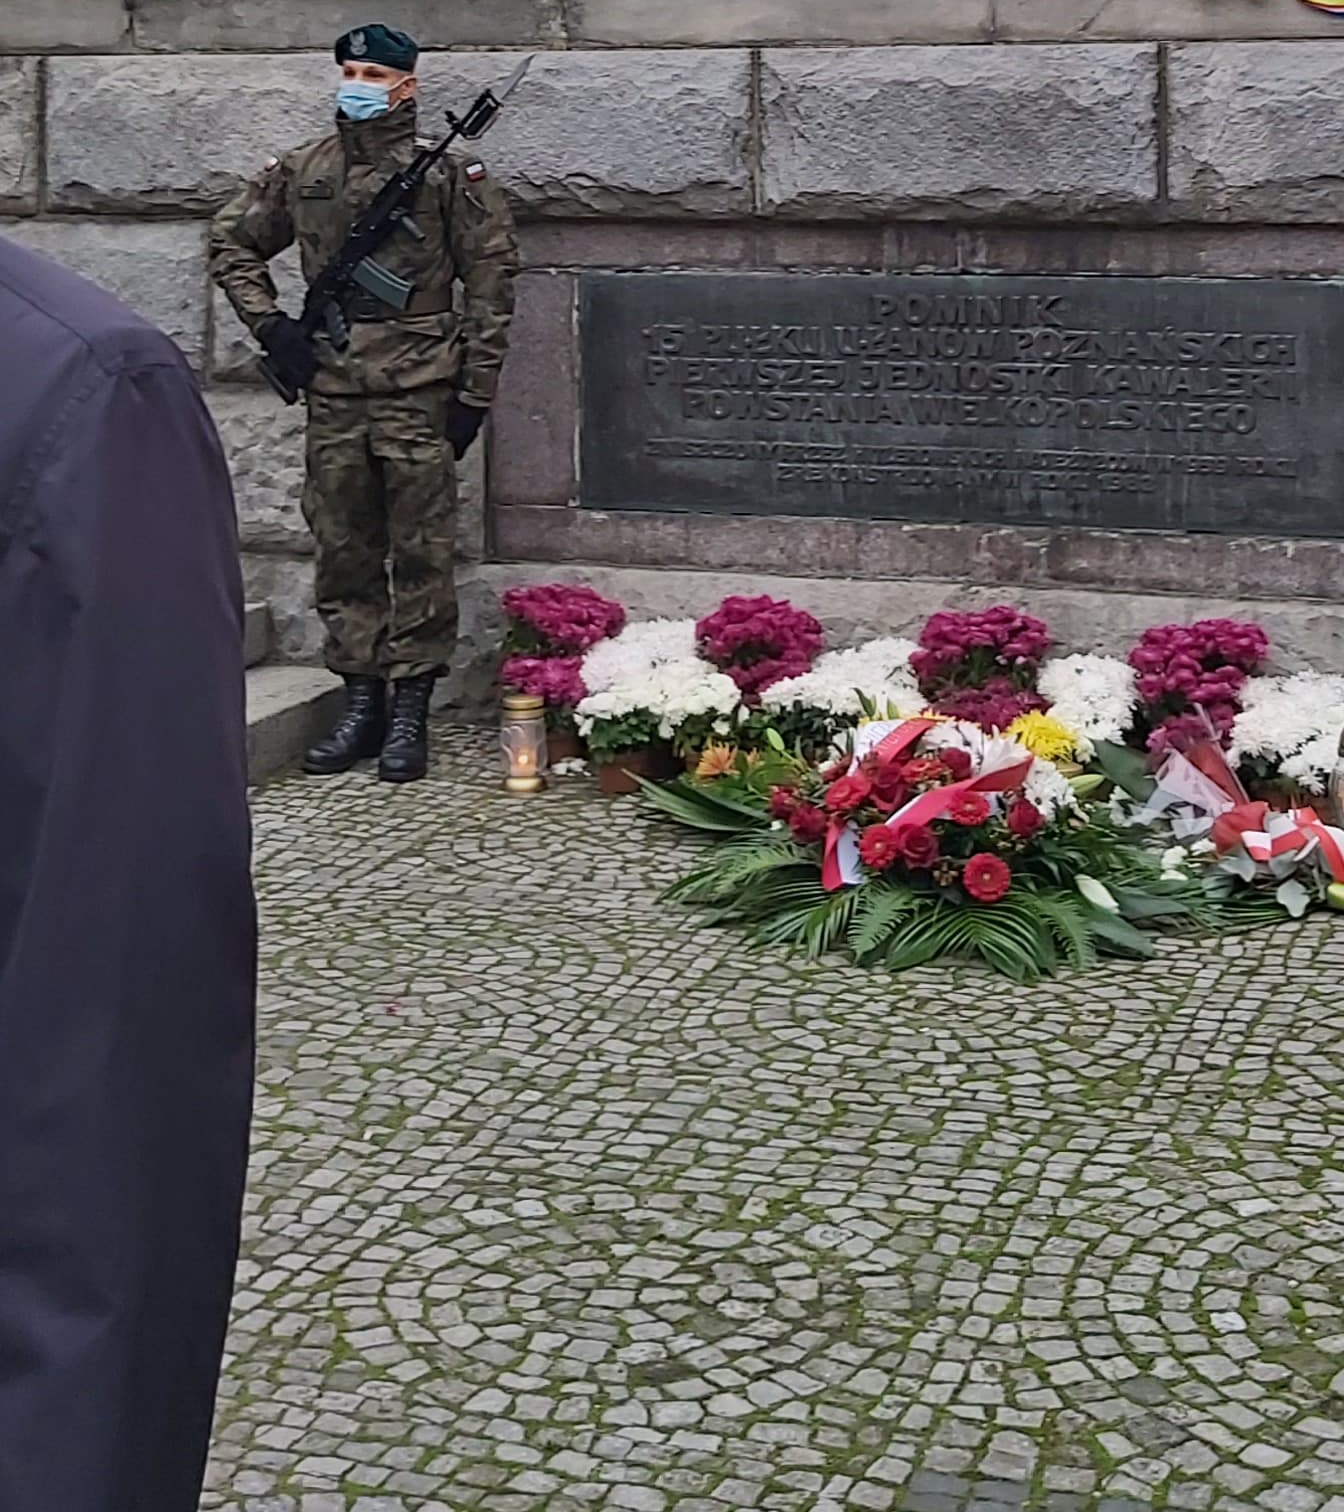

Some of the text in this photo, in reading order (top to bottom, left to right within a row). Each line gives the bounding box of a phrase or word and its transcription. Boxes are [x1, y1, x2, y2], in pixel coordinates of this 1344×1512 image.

[870, 293, 1065, 327] POMNIK
[642, 322, 689, 356] 15
[1009, 325, 1298, 366] POZNAŃSKICH
[645, 356, 843, 390] PIERWSZEJ
[858, 359, 1072, 395] JEDNOSTKI
[682, 388, 1256, 434] POWSTANIA WIELKOPOLSKIEGO
